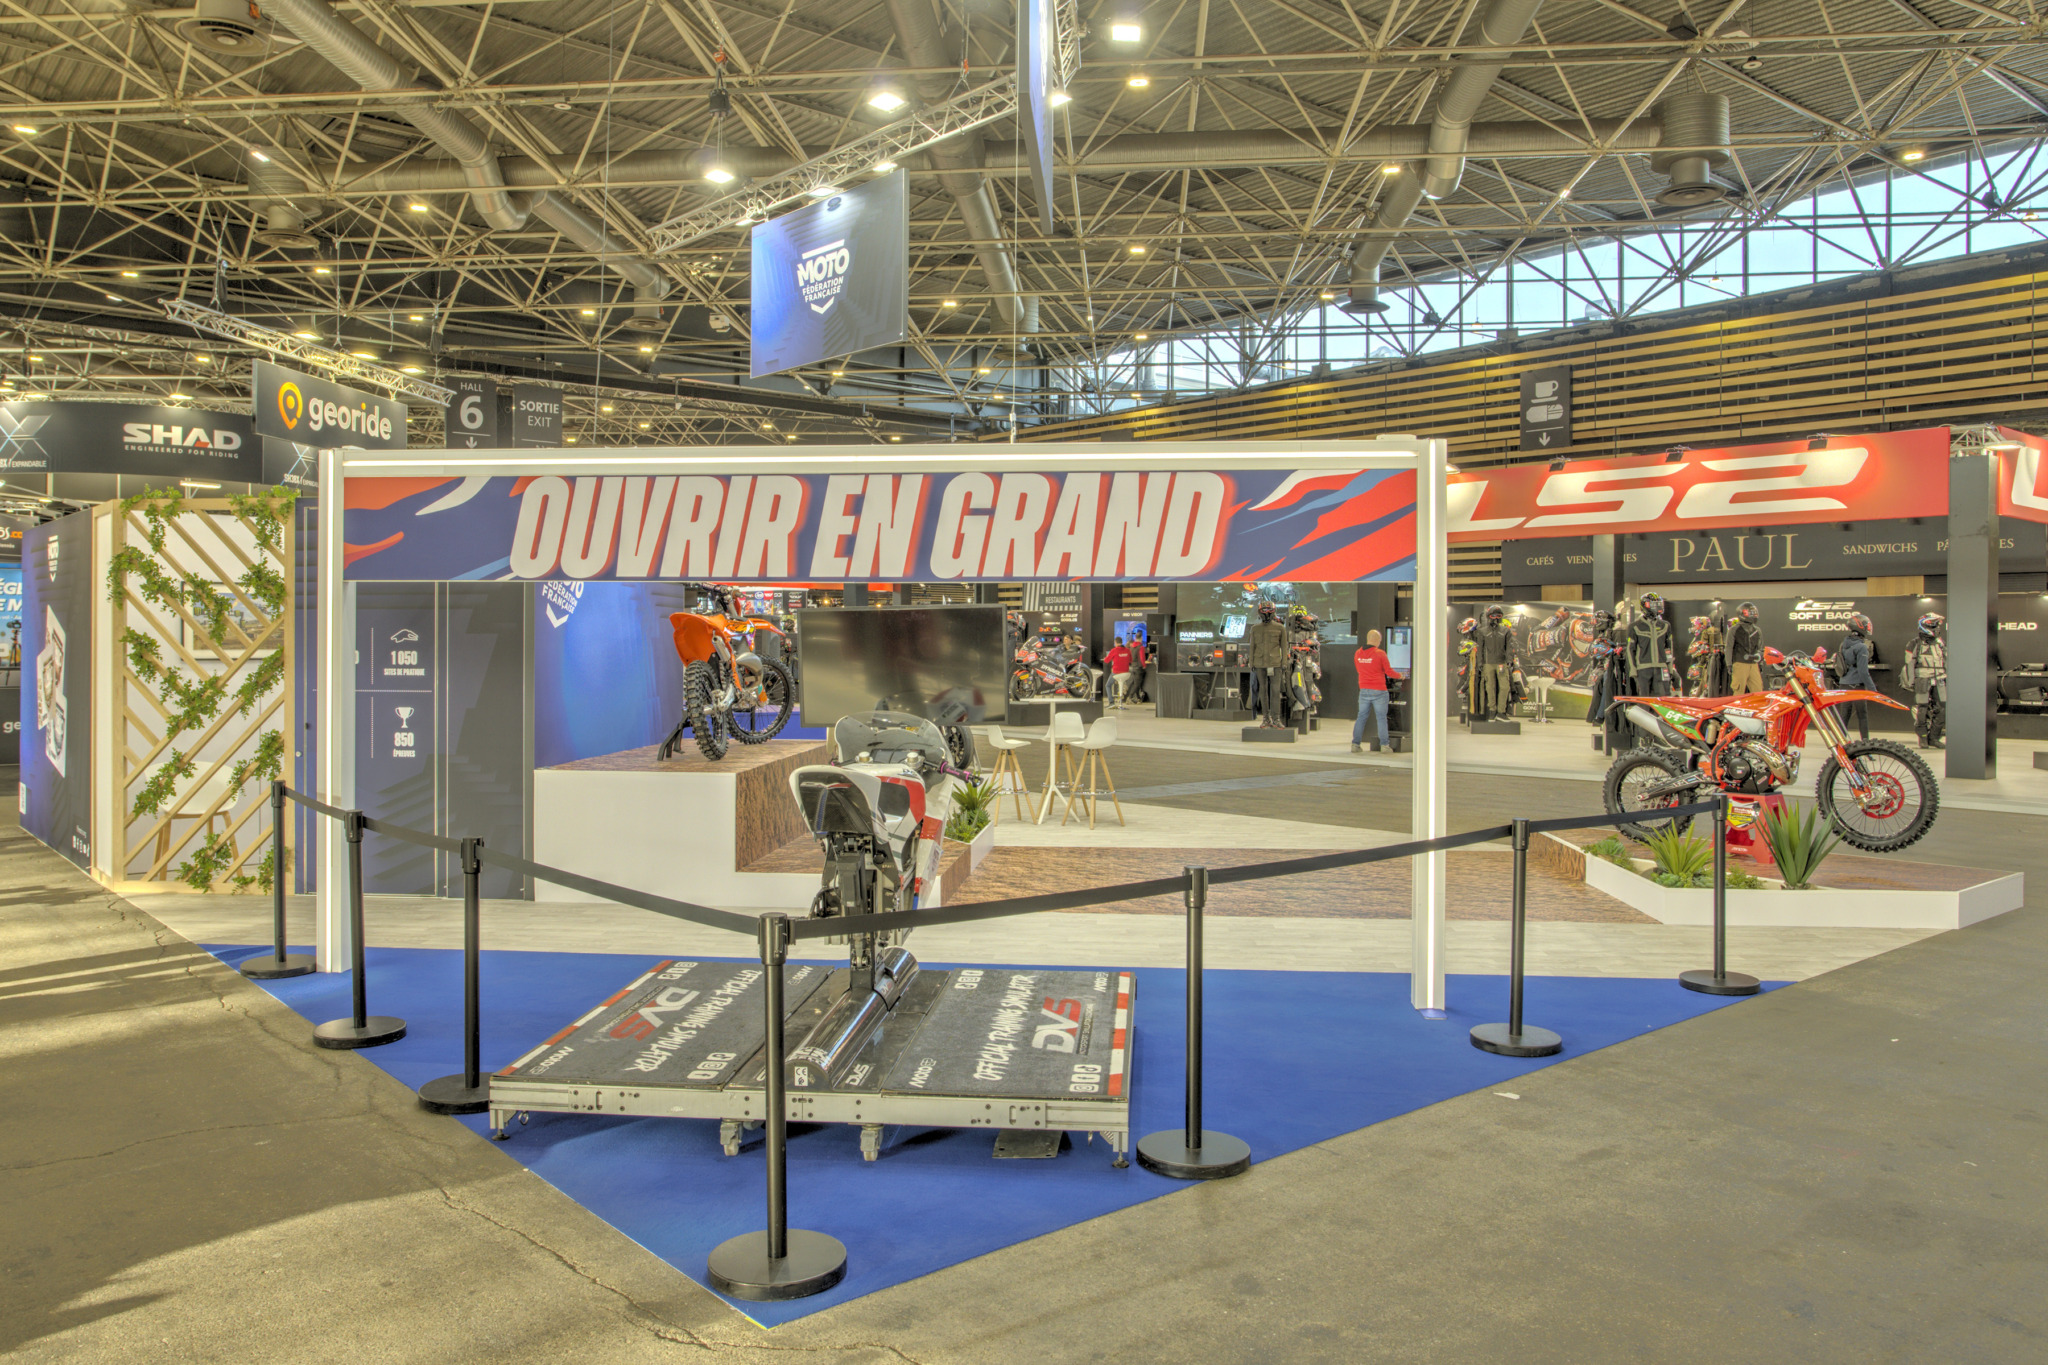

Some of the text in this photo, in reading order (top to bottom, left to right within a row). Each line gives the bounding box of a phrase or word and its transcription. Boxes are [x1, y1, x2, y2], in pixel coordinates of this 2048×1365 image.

[797, 248, 850, 287] MOTO
[802, 276, 844, 296] FÉDÉRATION
[804, 286, 841, 303] FRANÇAISE
[460, 382, 483, 393] HALL
[459, 395, 484, 430] 6
[519, 400, 560, 414] SORTIE
[308, 396, 392, 440] georide
[527, 415, 552, 428] EXIT
[123, 422, 242, 451] SHAD
[125, 445, 183, 454] ENGINEERED
[209, 451, 239, 459] RIDING
[12, 460, 47, 468] EXPANDABLE
[510, 472, 1225, 580] OUVRIR EN GRAND
[1668, 533, 1813, 573] PAUL
[1843, 542, 1919, 555] SANDWICHS
[1526, 556, 1554, 566] CAFÉS
[542, 584, 576, 614] FRANÇAISE
[1045, 596, 1076, 604] RESTAURANTS
[1795, 599, 1855, 610] LS2
[1789, 612, 1822, 620] SOFT
[384, 668, 425, 676] SITES DE PRATIQUE
[1665, 711, 1680, 721] 64
[394, 732, 415, 747] 850
